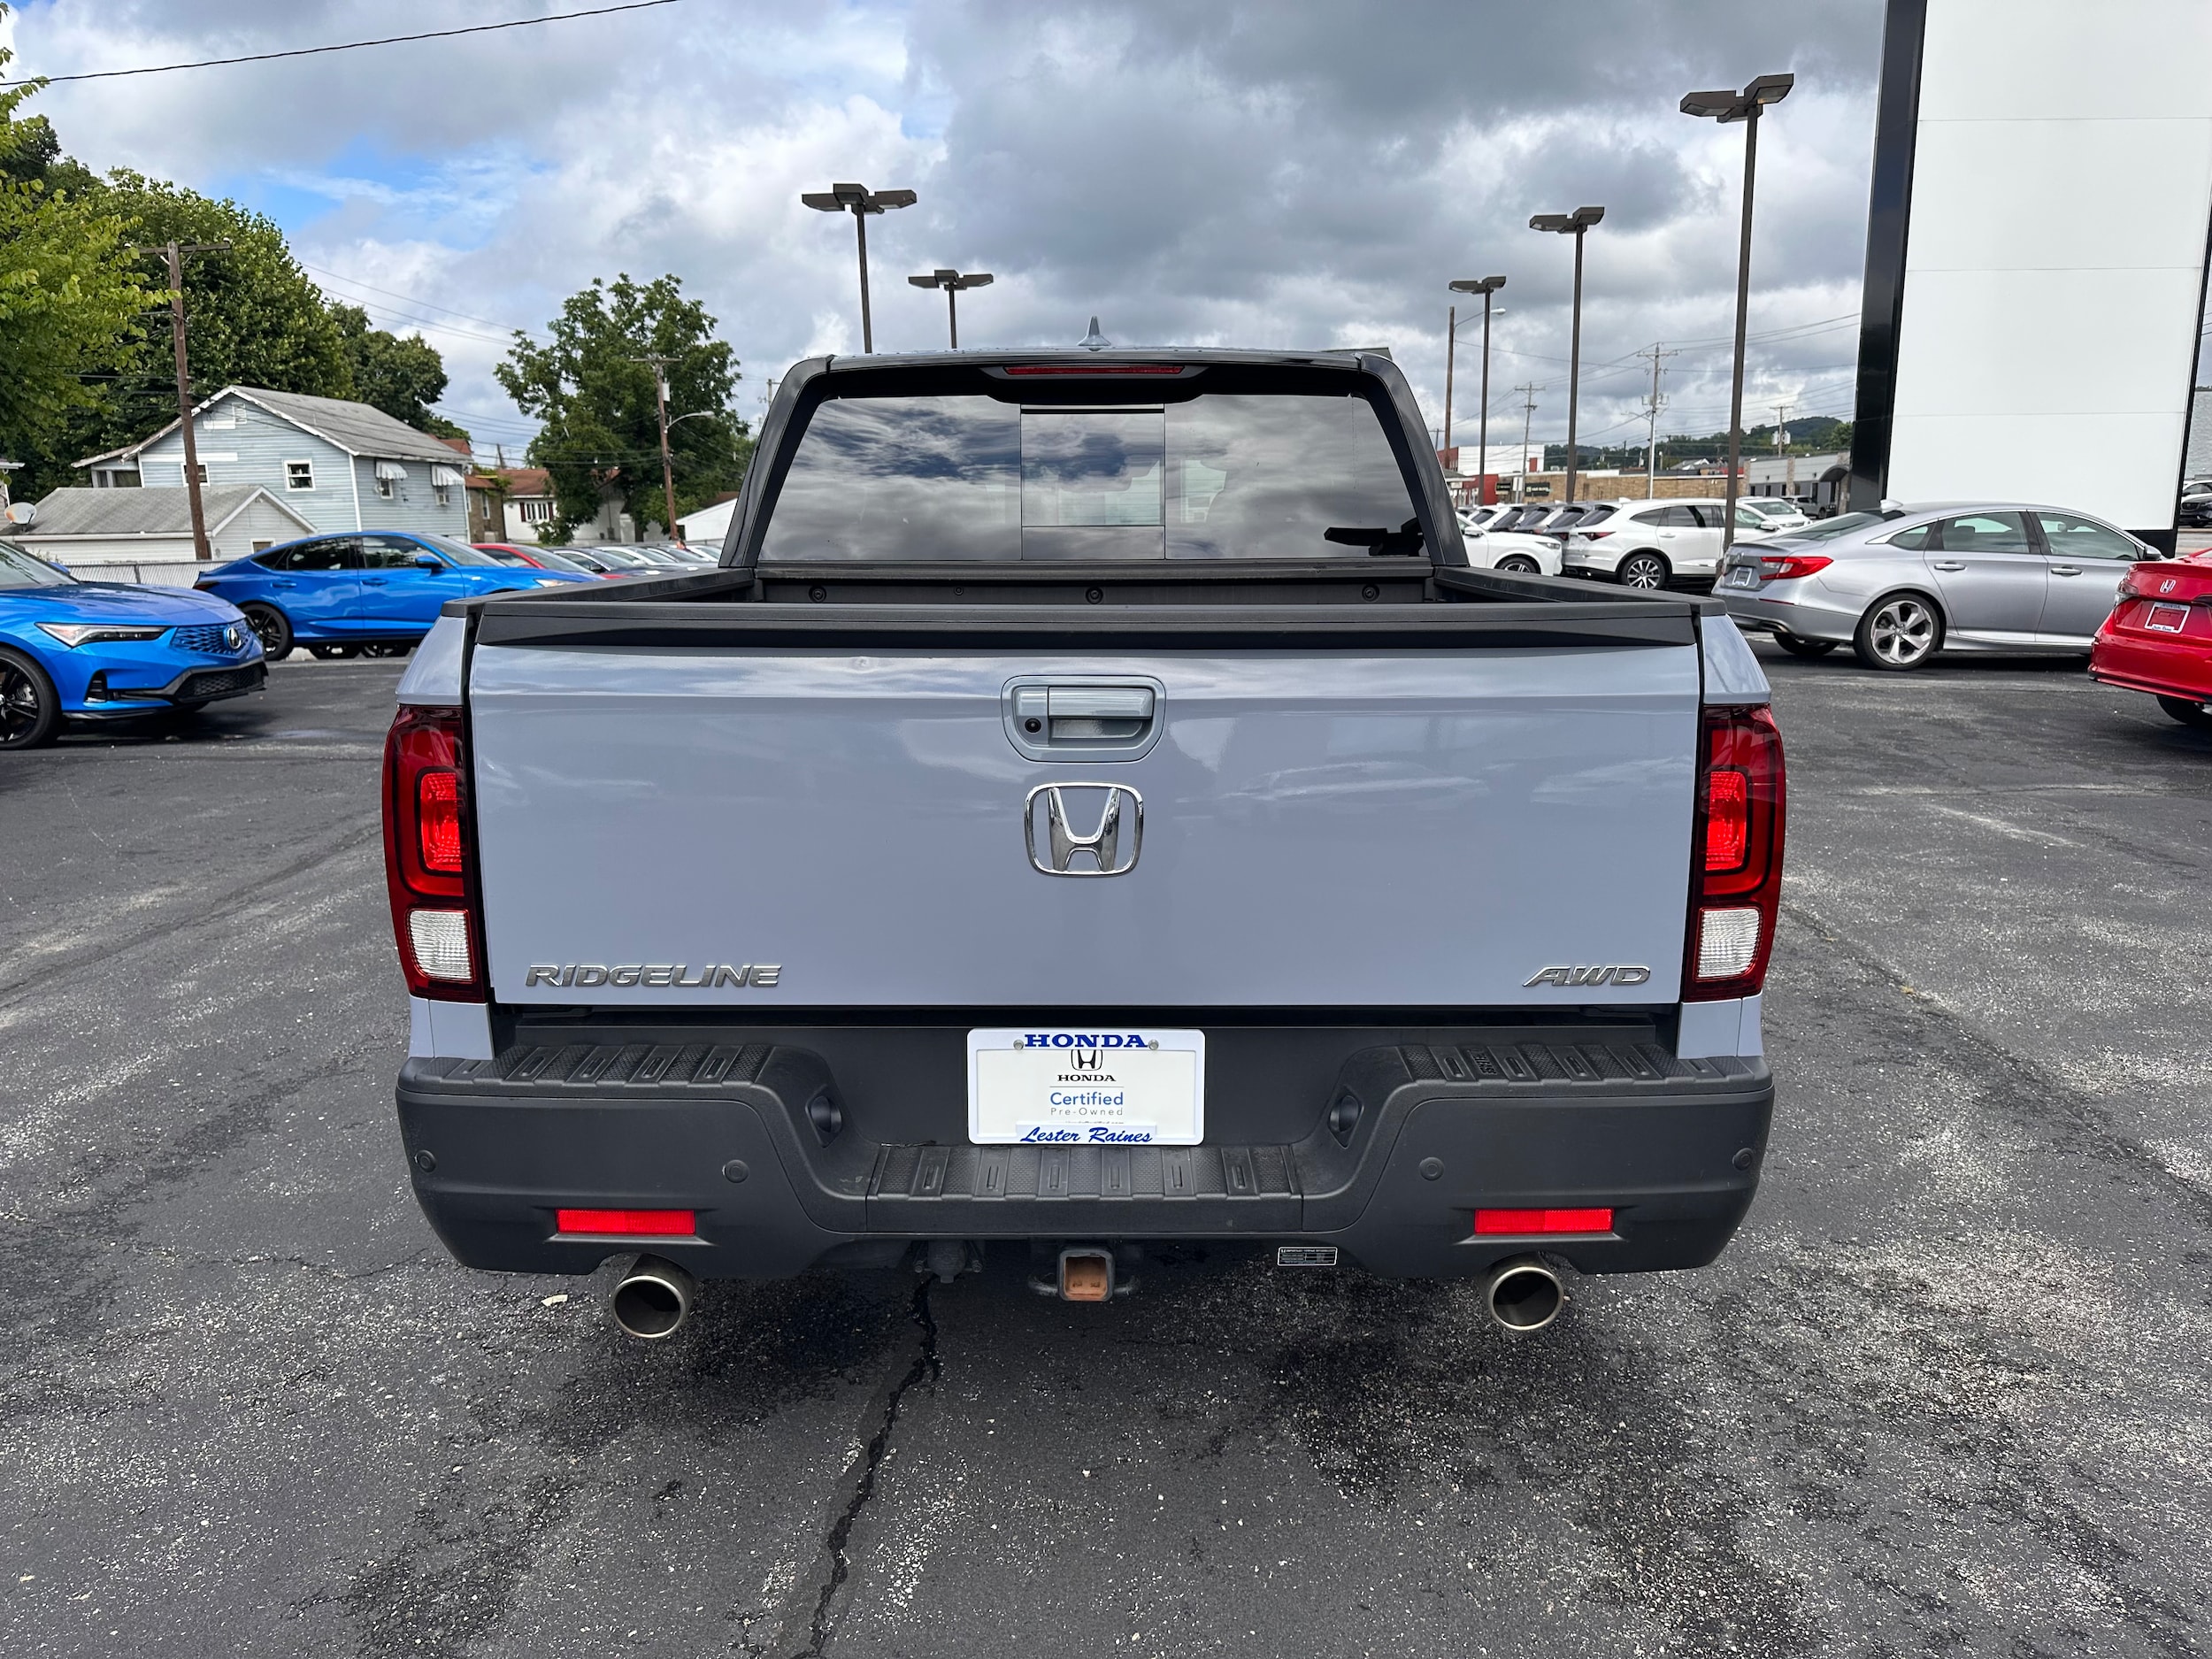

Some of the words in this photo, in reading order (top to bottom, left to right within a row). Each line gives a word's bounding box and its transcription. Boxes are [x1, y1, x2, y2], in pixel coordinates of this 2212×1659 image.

[526, 964, 782, 987] RIDGELINE
[1522, 964, 1651, 987] AWD
[1024, 1033, 1148, 1048] HONDA
[1049, 1091, 1124, 1106] Certified
[1050, 1107, 1124, 1116] Pre-Owned
[1019, 1126, 1081, 1143] Lester
[1087, 1126, 1153, 1143] Raines
